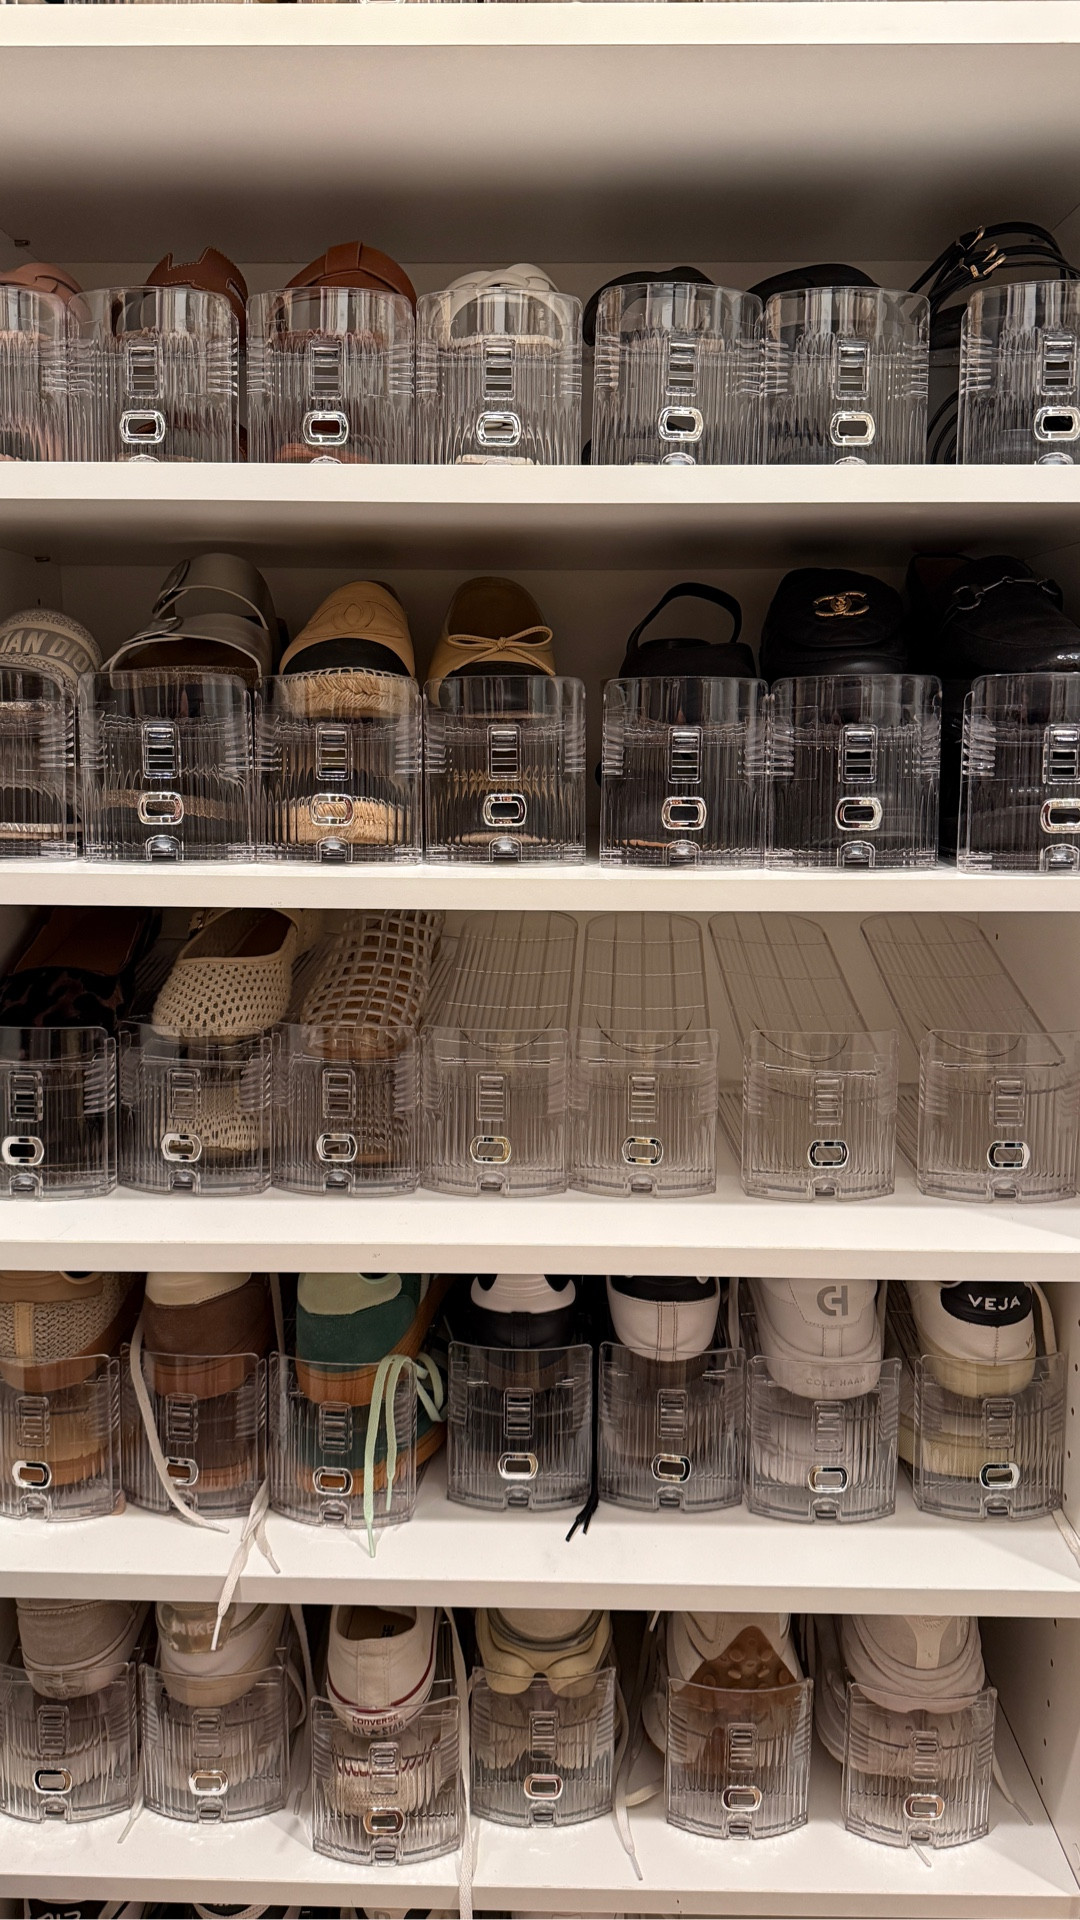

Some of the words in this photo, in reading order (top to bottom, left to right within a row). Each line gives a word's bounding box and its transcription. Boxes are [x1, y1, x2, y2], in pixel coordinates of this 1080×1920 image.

[0, 630, 48, 653] IAN
[968, 1293, 1020, 1310] VEJA
[806, 1377, 834, 1387] COLE
[840, 1375, 866, 1386] HAAN
[172, 1619, 216, 1636] NIKE
[352, 1713, 399, 1726] CONVERSE
[382, 1721, 404, 1736] STAR
